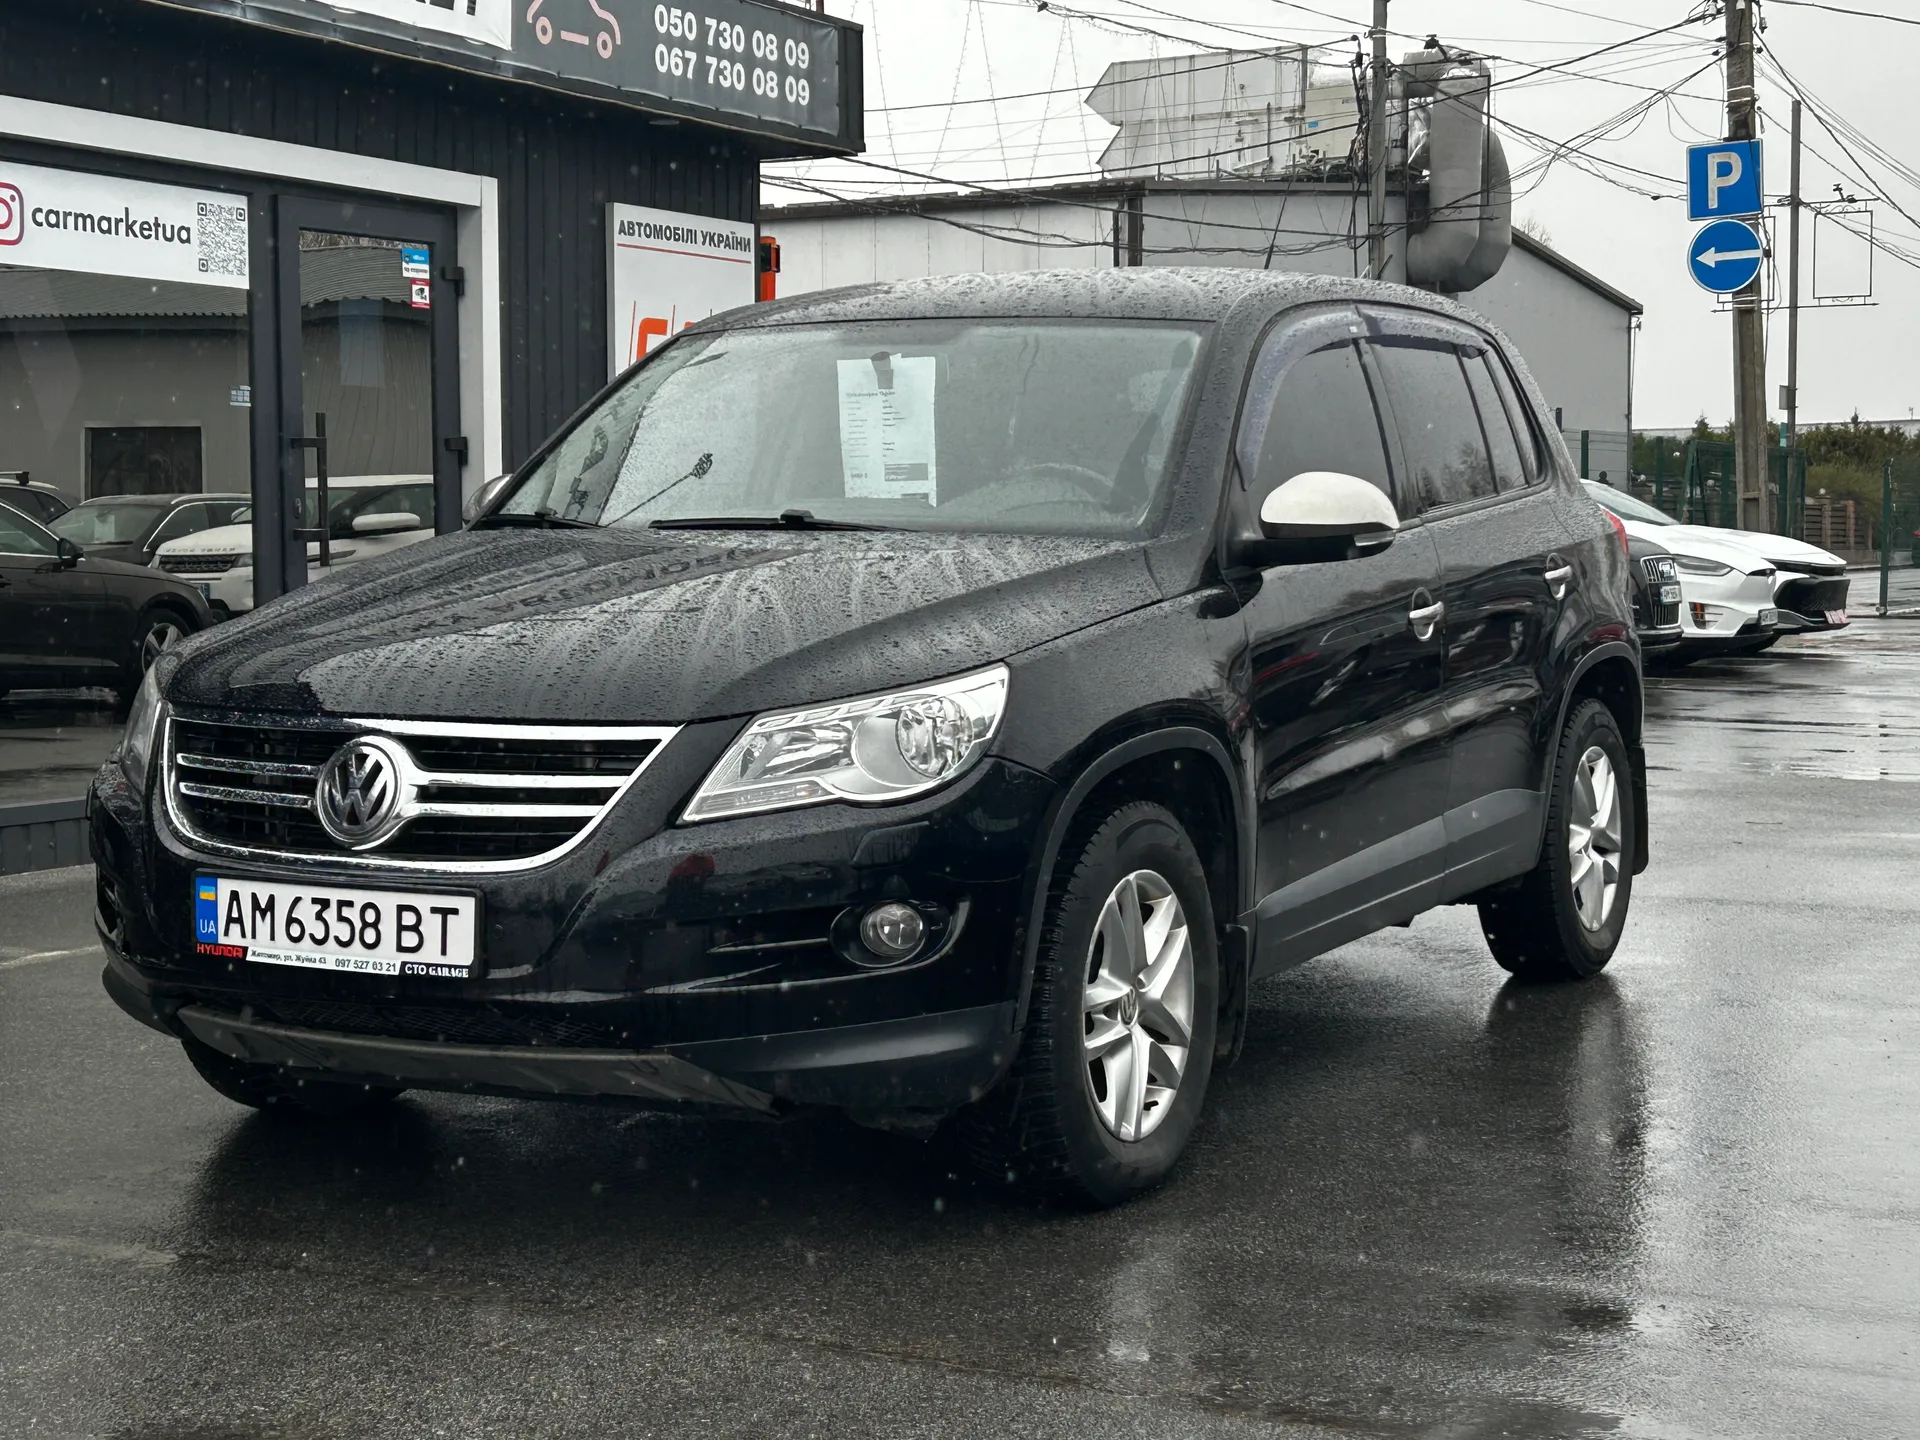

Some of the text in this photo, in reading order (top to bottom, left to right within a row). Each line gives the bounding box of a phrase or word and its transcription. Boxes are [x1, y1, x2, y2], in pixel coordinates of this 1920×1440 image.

[654, 4, 810, 69] 050 730 08 09
[655, 43, 810, 106] 067 730 08 09
[1707, 151, 1743, 209] P
[31, 207, 192, 246] carmarketua
[618, 219, 751, 253] АВТОМОБІЛІ УКРАЇНИ
[200, 920, 217, 934] UA
[285, 896, 382, 950] 6358
[197, 943, 243, 958] HYUNDAI
[334, 958, 351, 968] 097
[353, 960, 370, 970] 527
[385, 963, 396, 972] 21
[429, 966, 469, 978] GARAGE
